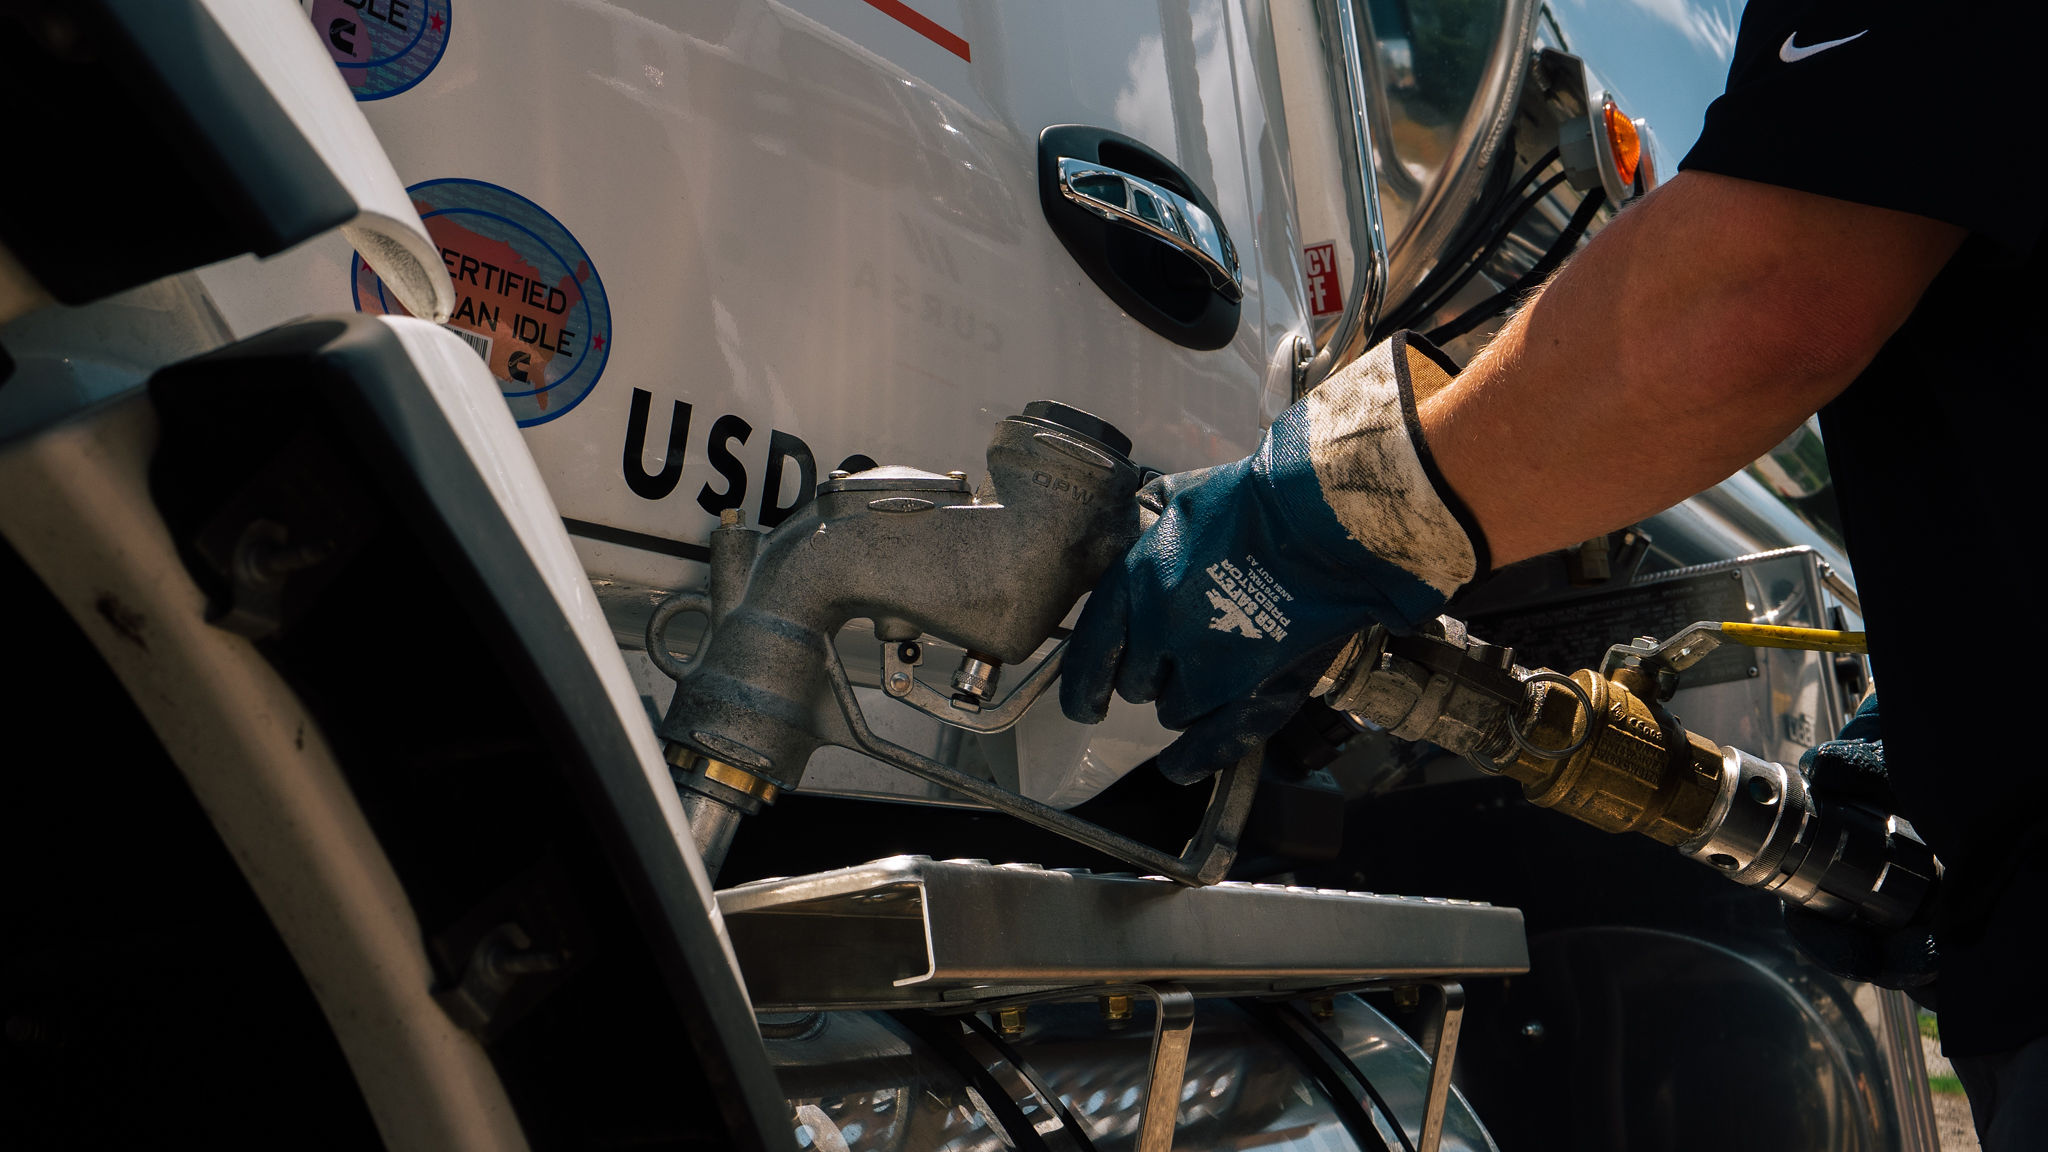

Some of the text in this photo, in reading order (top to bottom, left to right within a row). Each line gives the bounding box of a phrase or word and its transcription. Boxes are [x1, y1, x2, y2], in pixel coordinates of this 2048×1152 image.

[343, 0, 409, 31] LE
[436, 246, 567, 315] ERTIFIED
[1304, 246, 1331, 275] CY
[450, 293, 576, 358] AN IDLE
[622, 387, 879, 528] USD
[1032, 471, 1094, 505] OPW
[1205, 563, 1288, 643] MCR SAFETY
[1220, 558, 1291, 627] PREDATOR
[1246, 554, 1294, 602] ANSI CUT A3
